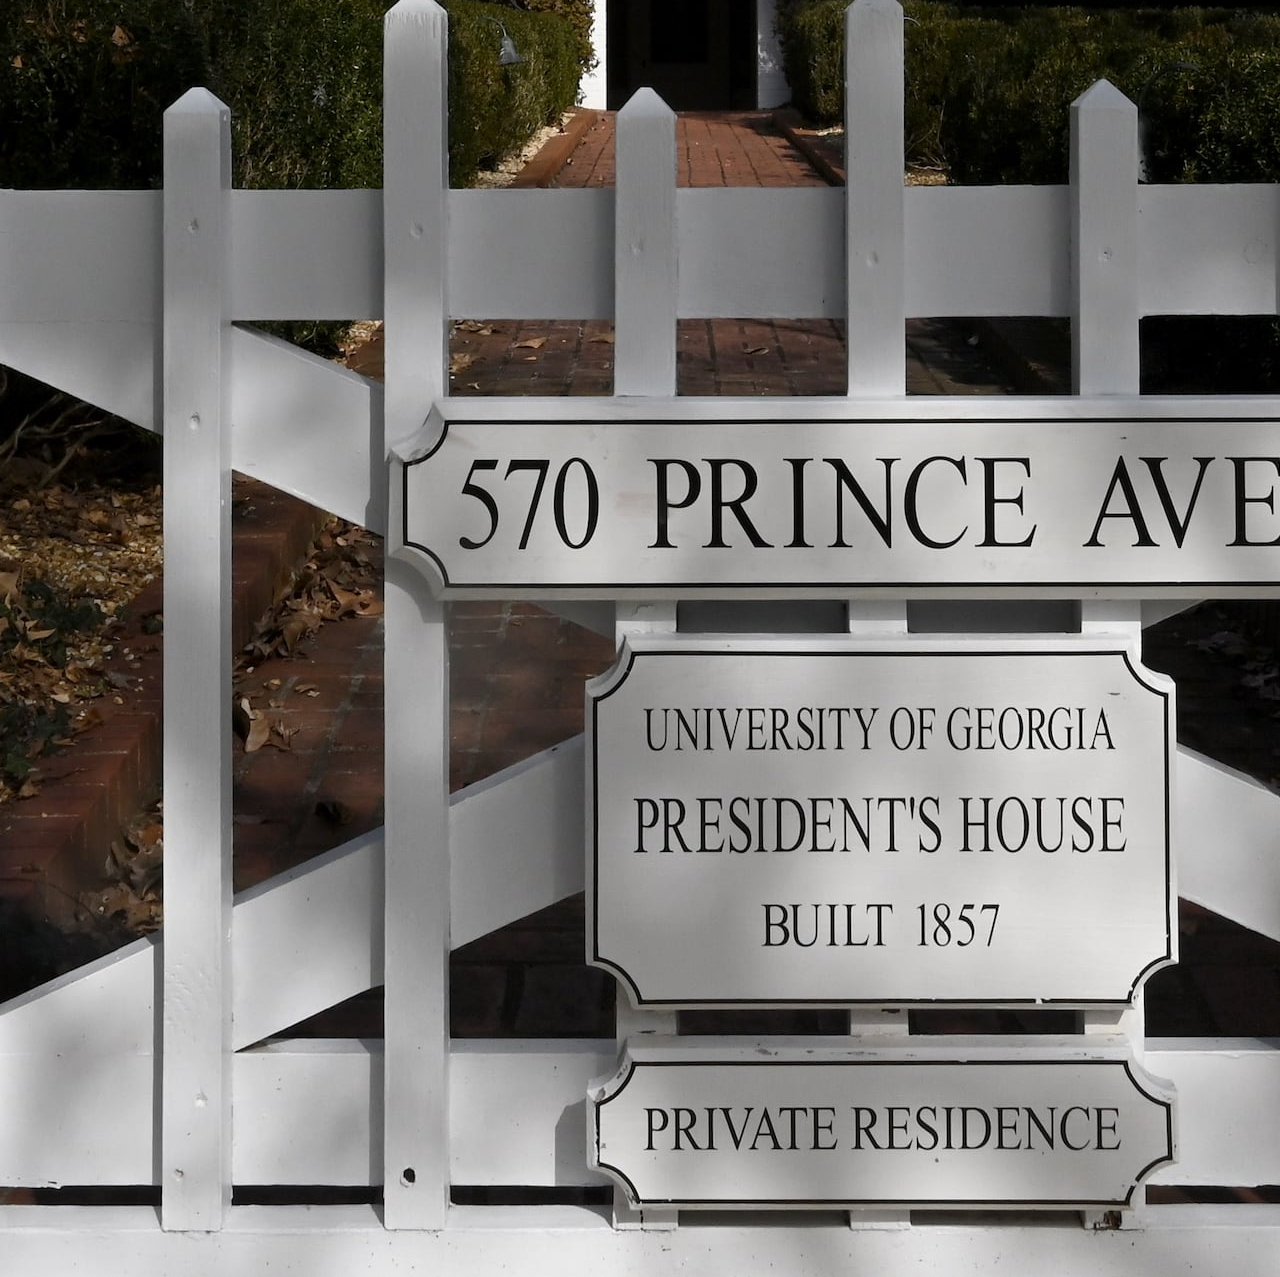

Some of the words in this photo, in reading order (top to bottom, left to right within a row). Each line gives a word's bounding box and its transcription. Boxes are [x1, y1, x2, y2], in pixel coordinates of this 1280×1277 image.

[460, 458, 598, 549] 570
[647, 456, 1036, 549] PRINCE
[644, 708, 878, 751] UNIVERSITY
[890, 708, 935, 750] OF
[947, 707, 1115, 750] GEORGIA
[634, 797, 941, 853] PRESIDENT'S
[960, 797, 1125, 852] HOUSE
[762, 905, 892, 947] BUILT
[919, 904, 999, 946] 1857
[646, 1108, 837, 1150] PRIVATE
[852, 1107, 1121, 1150] RESIDENCE
